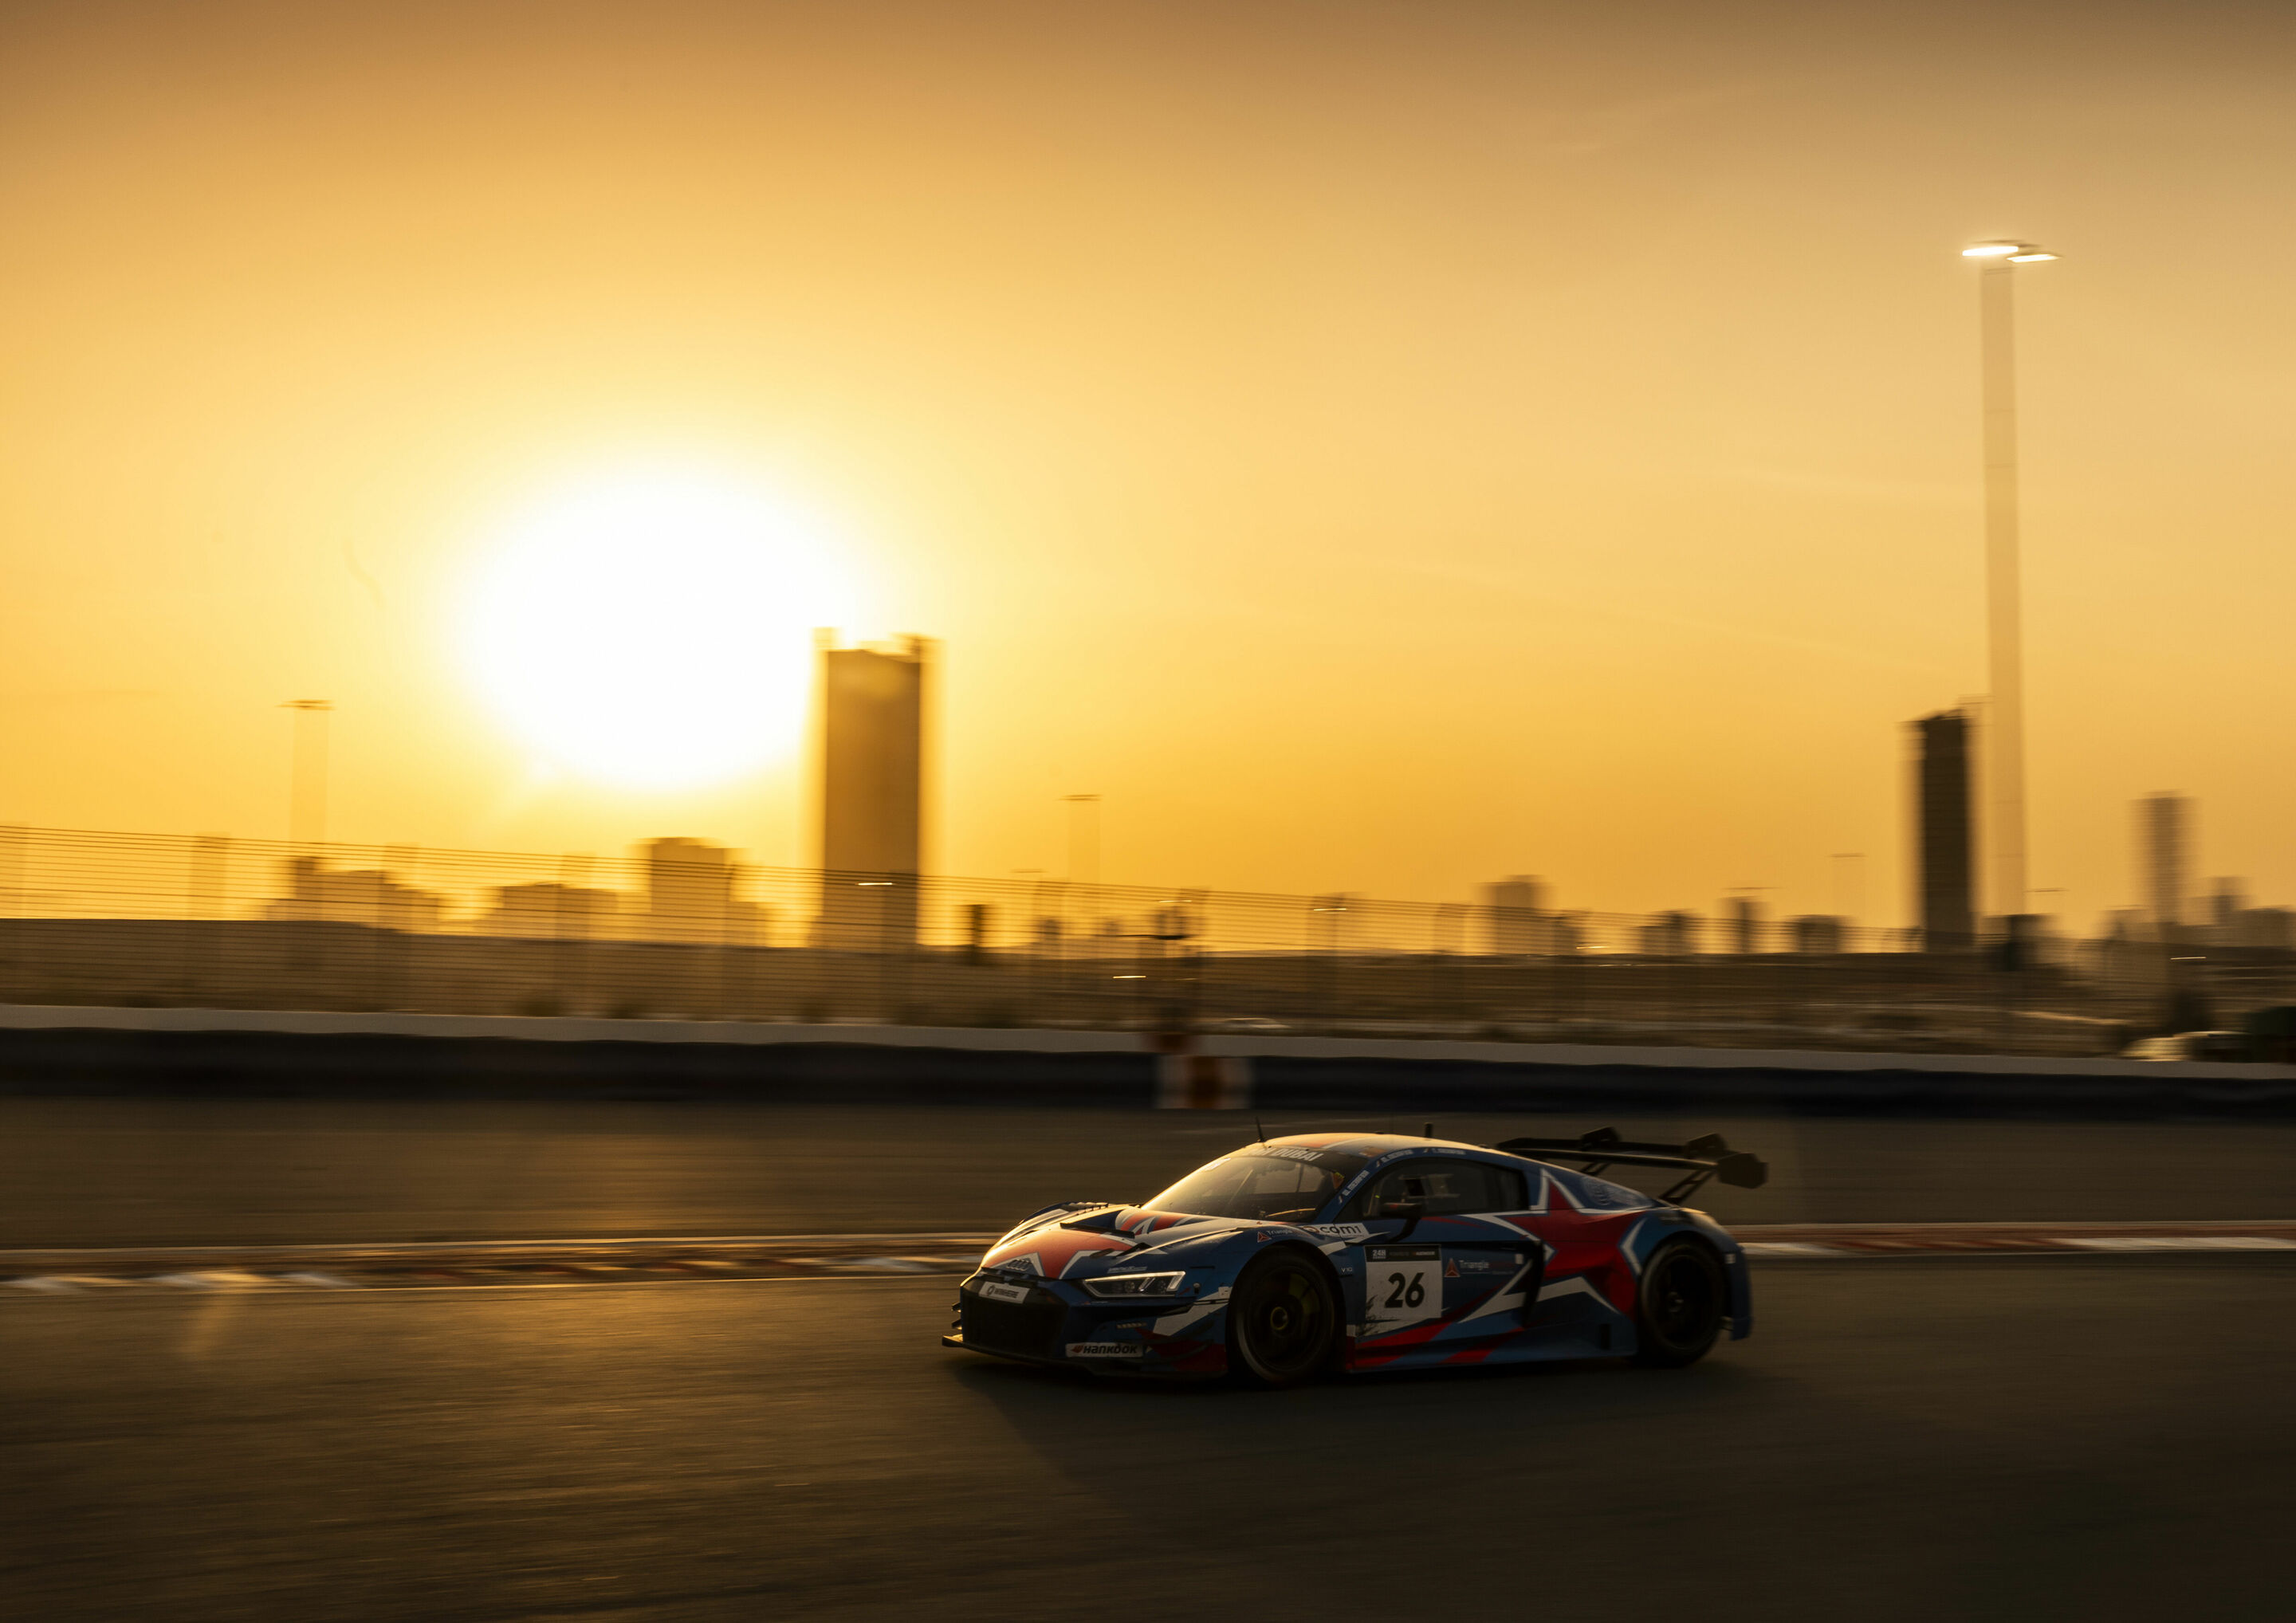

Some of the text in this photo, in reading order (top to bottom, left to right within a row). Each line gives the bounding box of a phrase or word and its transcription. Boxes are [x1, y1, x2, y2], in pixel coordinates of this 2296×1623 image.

[1270, 1148, 1324, 1161] DUBAI
[1458, 1259, 1489, 1271] Triangle
[1384, 1272, 1425, 1308] 26
